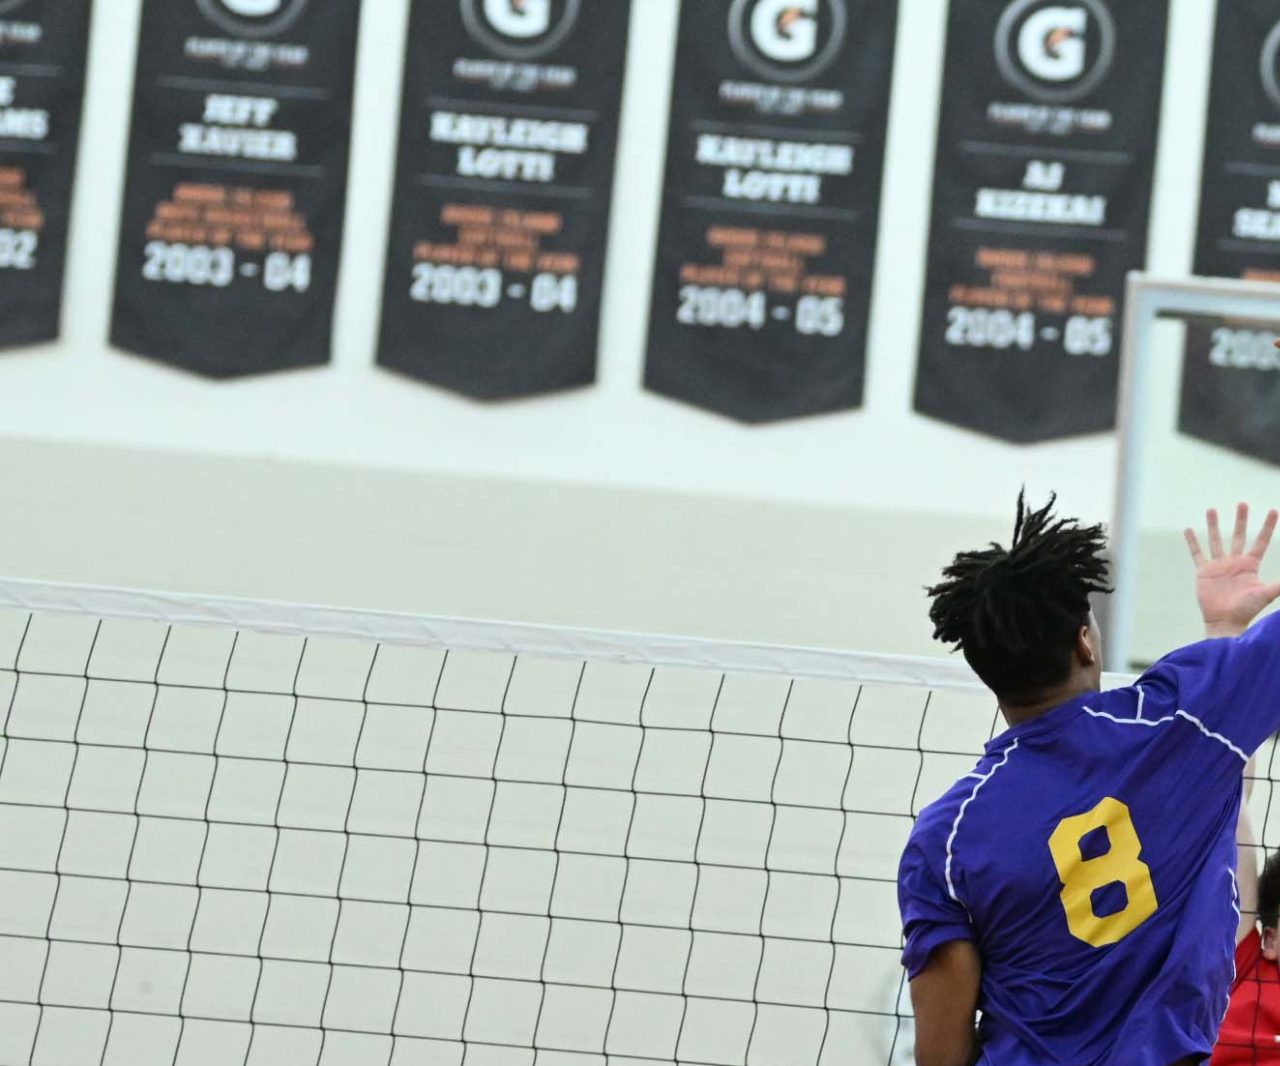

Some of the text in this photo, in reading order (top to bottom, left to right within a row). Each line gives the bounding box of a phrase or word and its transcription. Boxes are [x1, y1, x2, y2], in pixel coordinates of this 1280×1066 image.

[1018, 7, 1086, 80] G
[143, 241, 234, 287] 2003
[264, 252, 311, 292] 04
[411, 262, 501, 308] 2003
[530, 272, 577, 313] 04
[677, 285, 765, 329] 2004
[796, 295, 844, 336] 05
[946, 306, 1035, 349] 2004
[1064, 315, 1112, 355] 05
[1048, 796, 1158, 948] 8
